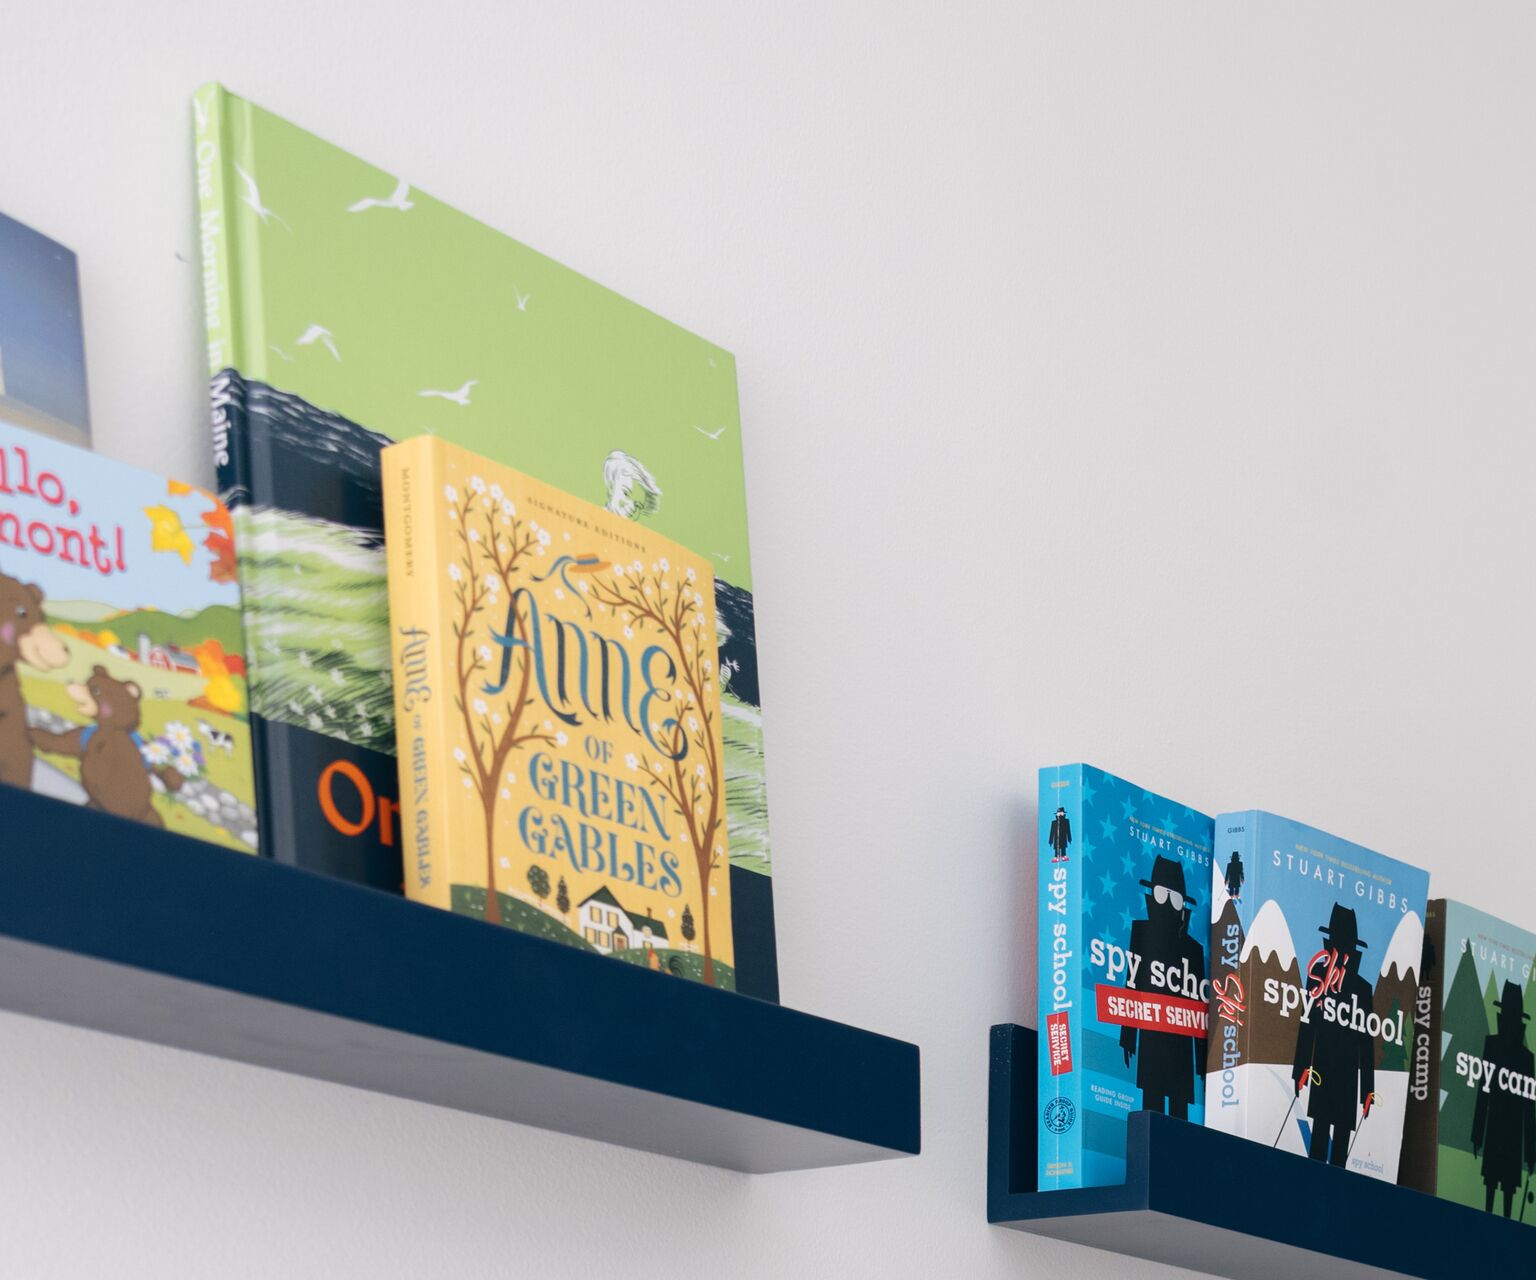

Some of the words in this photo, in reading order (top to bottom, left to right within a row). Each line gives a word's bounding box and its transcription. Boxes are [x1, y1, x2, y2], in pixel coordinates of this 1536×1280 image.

[209, 375, 232, 468] Maine
[412, 737, 430, 807] GREEN
[584, 734, 615, 765] OF
[528, 751, 672, 842] GREEN
[413, 808, 433, 889] GABLES
[518, 805, 684, 898] GABLES
[1129, 826, 1172, 851] STUART
[1176, 845, 1210, 867] GIBBS
[1227, 826, 1246, 834] GIBBS
[1048, 867, 1067, 915] spy
[1272, 850, 1345, 889] STUART
[1354, 880, 1408, 913] GIBBS
[1052, 923, 1073, 1012] school
[1090, 938, 1142, 990] spy
[1222, 924, 1240, 969] spy
[1460, 938, 1515, 973] STUART
[1307, 947, 1350, 999] Ski
[1107, 995, 1162, 1023] SECRET
[1213, 972, 1248, 1027] Ski
[1263, 978, 1316, 1024] spy
[1323, 994, 1404, 1046] school
[1414, 986, 1431, 1028] spy
[1050, 1023, 1062, 1066] SERVICE
[1058, 1023, 1069, 1061] SECRET
[1221, 1025, 1242, 1108] school
[1410, 1034, 1430, 1101] camp
[1456, 1052, 1496, 1094] spy
